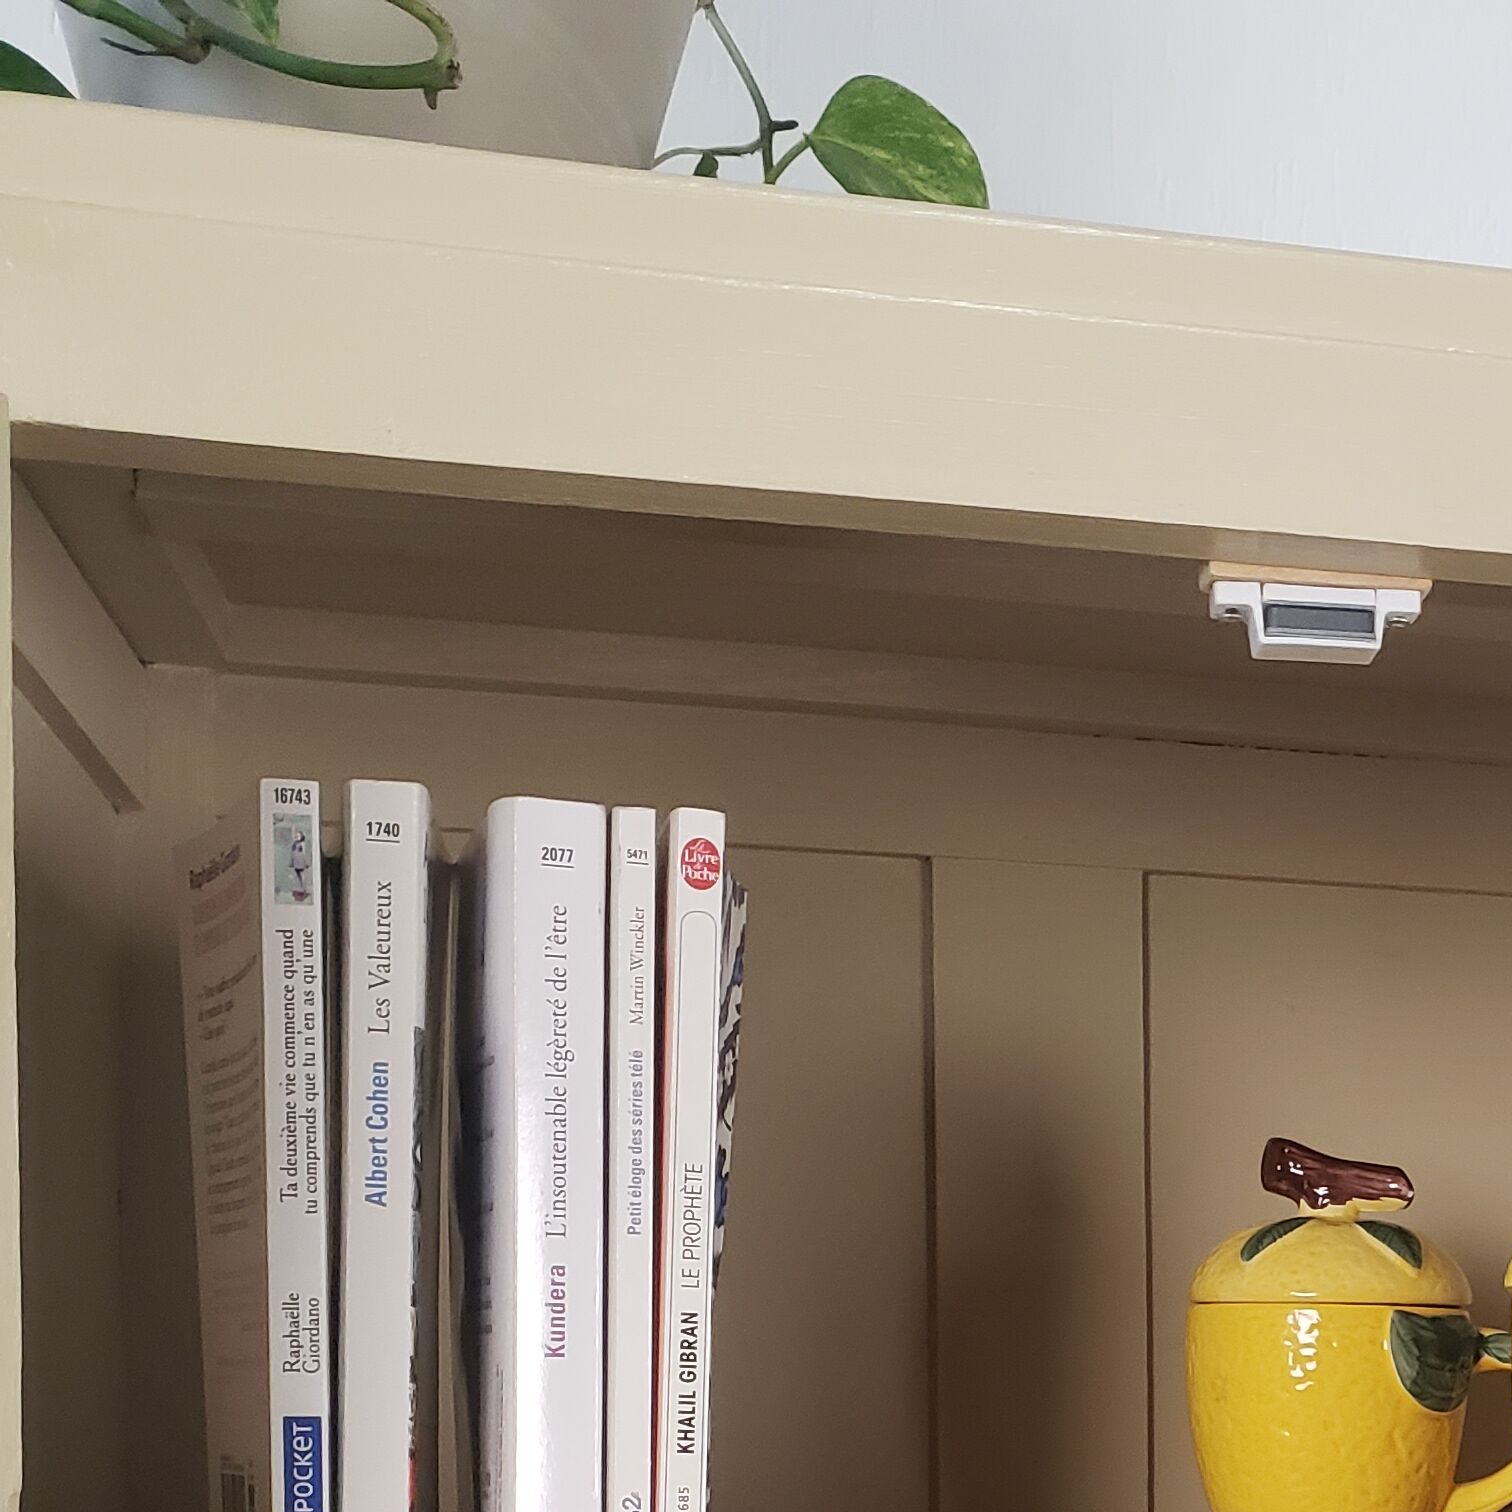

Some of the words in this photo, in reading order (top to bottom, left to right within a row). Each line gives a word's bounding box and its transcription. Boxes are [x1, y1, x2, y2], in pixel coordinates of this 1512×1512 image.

[273, 787, 311, 805] 16743
[366, 821, 400, 839] 1740
[541, 846, 574, 863] 2077
[627, 849, 648, 860] 5471
[682, 864, 719, 881] Poche
[684, 848, 720, 865] Livre
[367, 880, 393, 991] Valeureux
[544, 904, 568, 960] l'être
[629, 906, 646, 972] Winckler
[275, 929, 300, 981] quand
[303, 989, 316, 1005] as
[544, 966, 568, 993] de
[629, 976, 645, 1026] Martin
[282, 984, 298, 1068] commence
[367, 998, 391, 1035] Les
[544, 997, 576, 1079] légèreté
[303, 1052, 317, 1067] tu
[628, 1049, 645, 1078] télé
[279, 1073, 298, 1097] vie
[305, 1073, 320, 1102] que
[364, 1061, 390, 1131] Cohen
[628, 1081, 644, 1126] séries
[280, 1100, 299, 1177] deuxième
[298, 1107, 321, 1194] comprends
[628, 1127, 644, 1155] des
[364, 1137, 389, 1208] Albert
[544, 1085, 569, 1238] L'insoutenable
[628, 1158, 646, 1201] éloge
[280, 1182, 299, 1203] Ta
[304, 1200, 319, 1215] tu
[679, 1163, 705, 1261] PROPHÈTE
[627, 1201, 643, 1236] Petit
[680, 1269, 701, 1289] LE
[282, 1292, 303, 1374] Raphaëlle
[544, 1264, 567, 1359] Kundera
[302, 1297, 321, 1374] Giordano
[678, 1312, 699, 1383] GIBRAN
[676, 1390, 697, 1454] KHALIL
